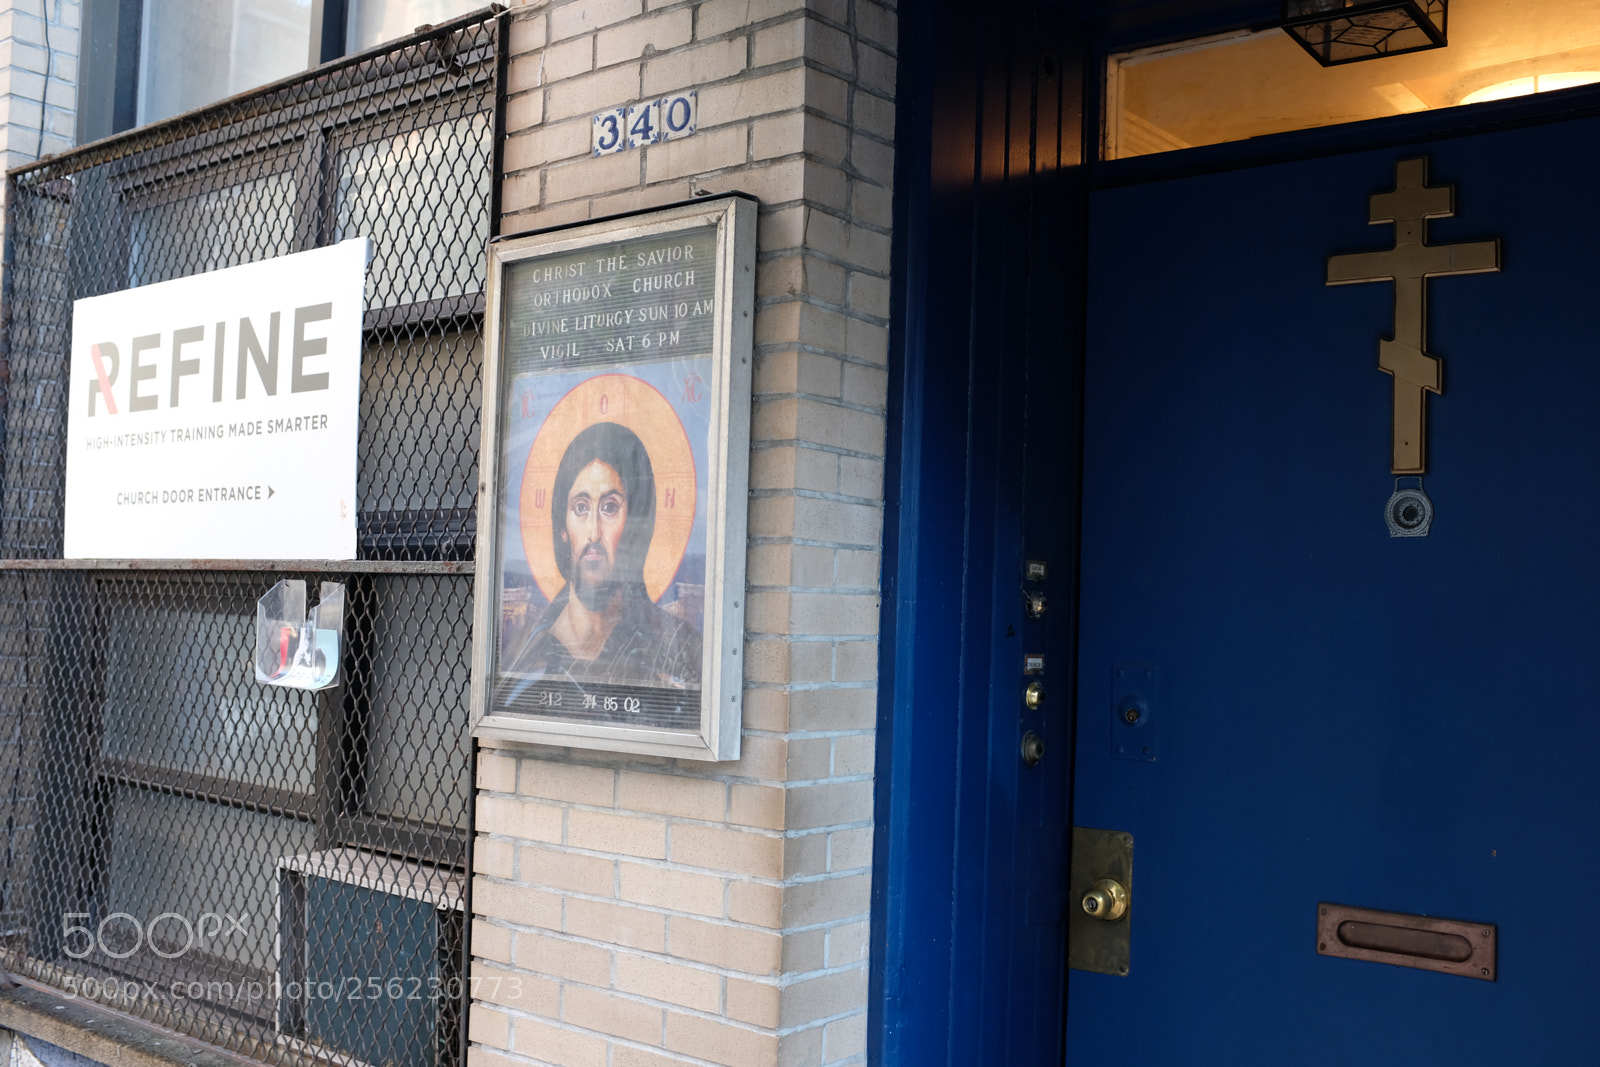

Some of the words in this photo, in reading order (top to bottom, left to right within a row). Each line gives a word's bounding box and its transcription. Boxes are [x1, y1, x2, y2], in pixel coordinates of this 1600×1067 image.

[598, 97, 691, 150] 340
[533, 262, 586, 283] CHRIST
[597, 256, 627, 273] THE
[637, 245, 694, 266] SAVIOR
[534, 282, 612, 307] ORTHODOX
[633, 271, 694, 293] CHURCH
[523, 318, 569, 337] DIVINE
[575, 309, 633, 331] LITURGY
[639, 305, 668, 322] SUN
[675, 303, 688, 318] 10
[693, 299, 714, 316] AM
[87, 301, 333, 417] REFINE
[540, 342, 580, 359] VIGIL
[606, 335, 635, 352] SAT
[642, 333, 651, 348] 6
[86, 430, 167, 451] HIGH-INTENSITY
[170, 424, 224, 441] TRAINING
[228, 421, 263, 438] MADE
[267, 414, 328, 434] SMARTER
[116, 491, 159, 506] CHURCH
[162, 489, 194, 504] DOOR
[198, 485, 262, 503] ENTRANCE
[539, 691, 562, 706] 212
[603, 696, 618, 711] 85
[623, 697, 640, 713] 02
